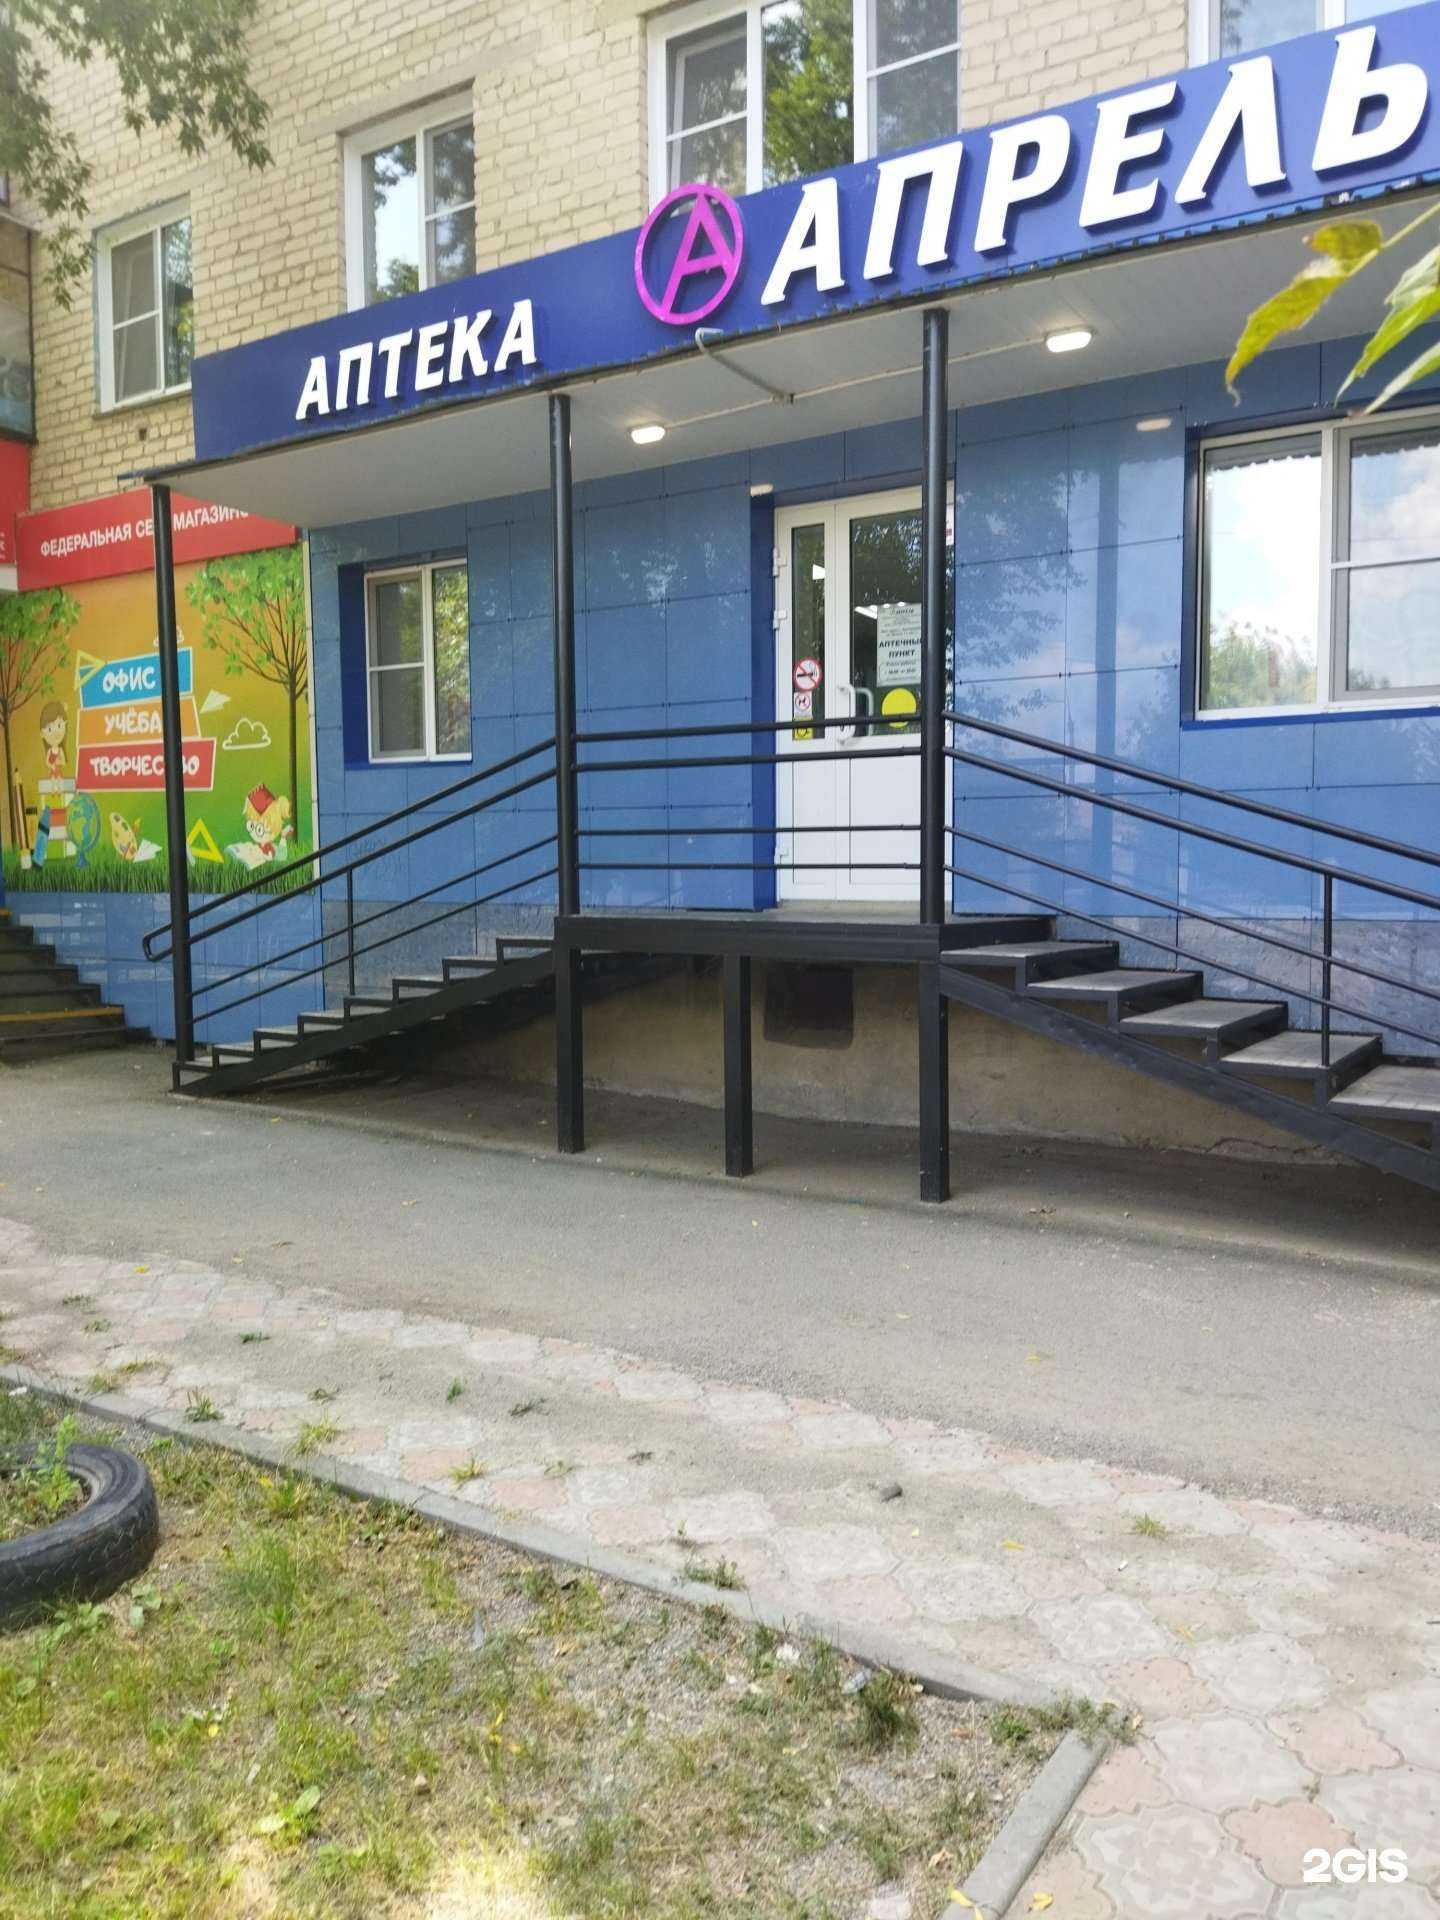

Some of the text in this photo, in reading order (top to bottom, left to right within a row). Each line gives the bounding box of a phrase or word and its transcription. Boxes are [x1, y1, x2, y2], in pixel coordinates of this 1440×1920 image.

[295, 299, 538, 421] АПТЕКА
[760, 24, 1428, 306] АПРЕЛЬ
[40, 522, 132, 558] ФЕДЕРАЛЬНАЯ
[135, 518, 155, 539] СЕ
[879, 639, 922, 649] АПТЕЧНЫ
[888, 649, 915, 660] ПУНКТ
[102, 666, 156, 694] ОФИС
[104, 706, 163, 736] УЧЁБА
